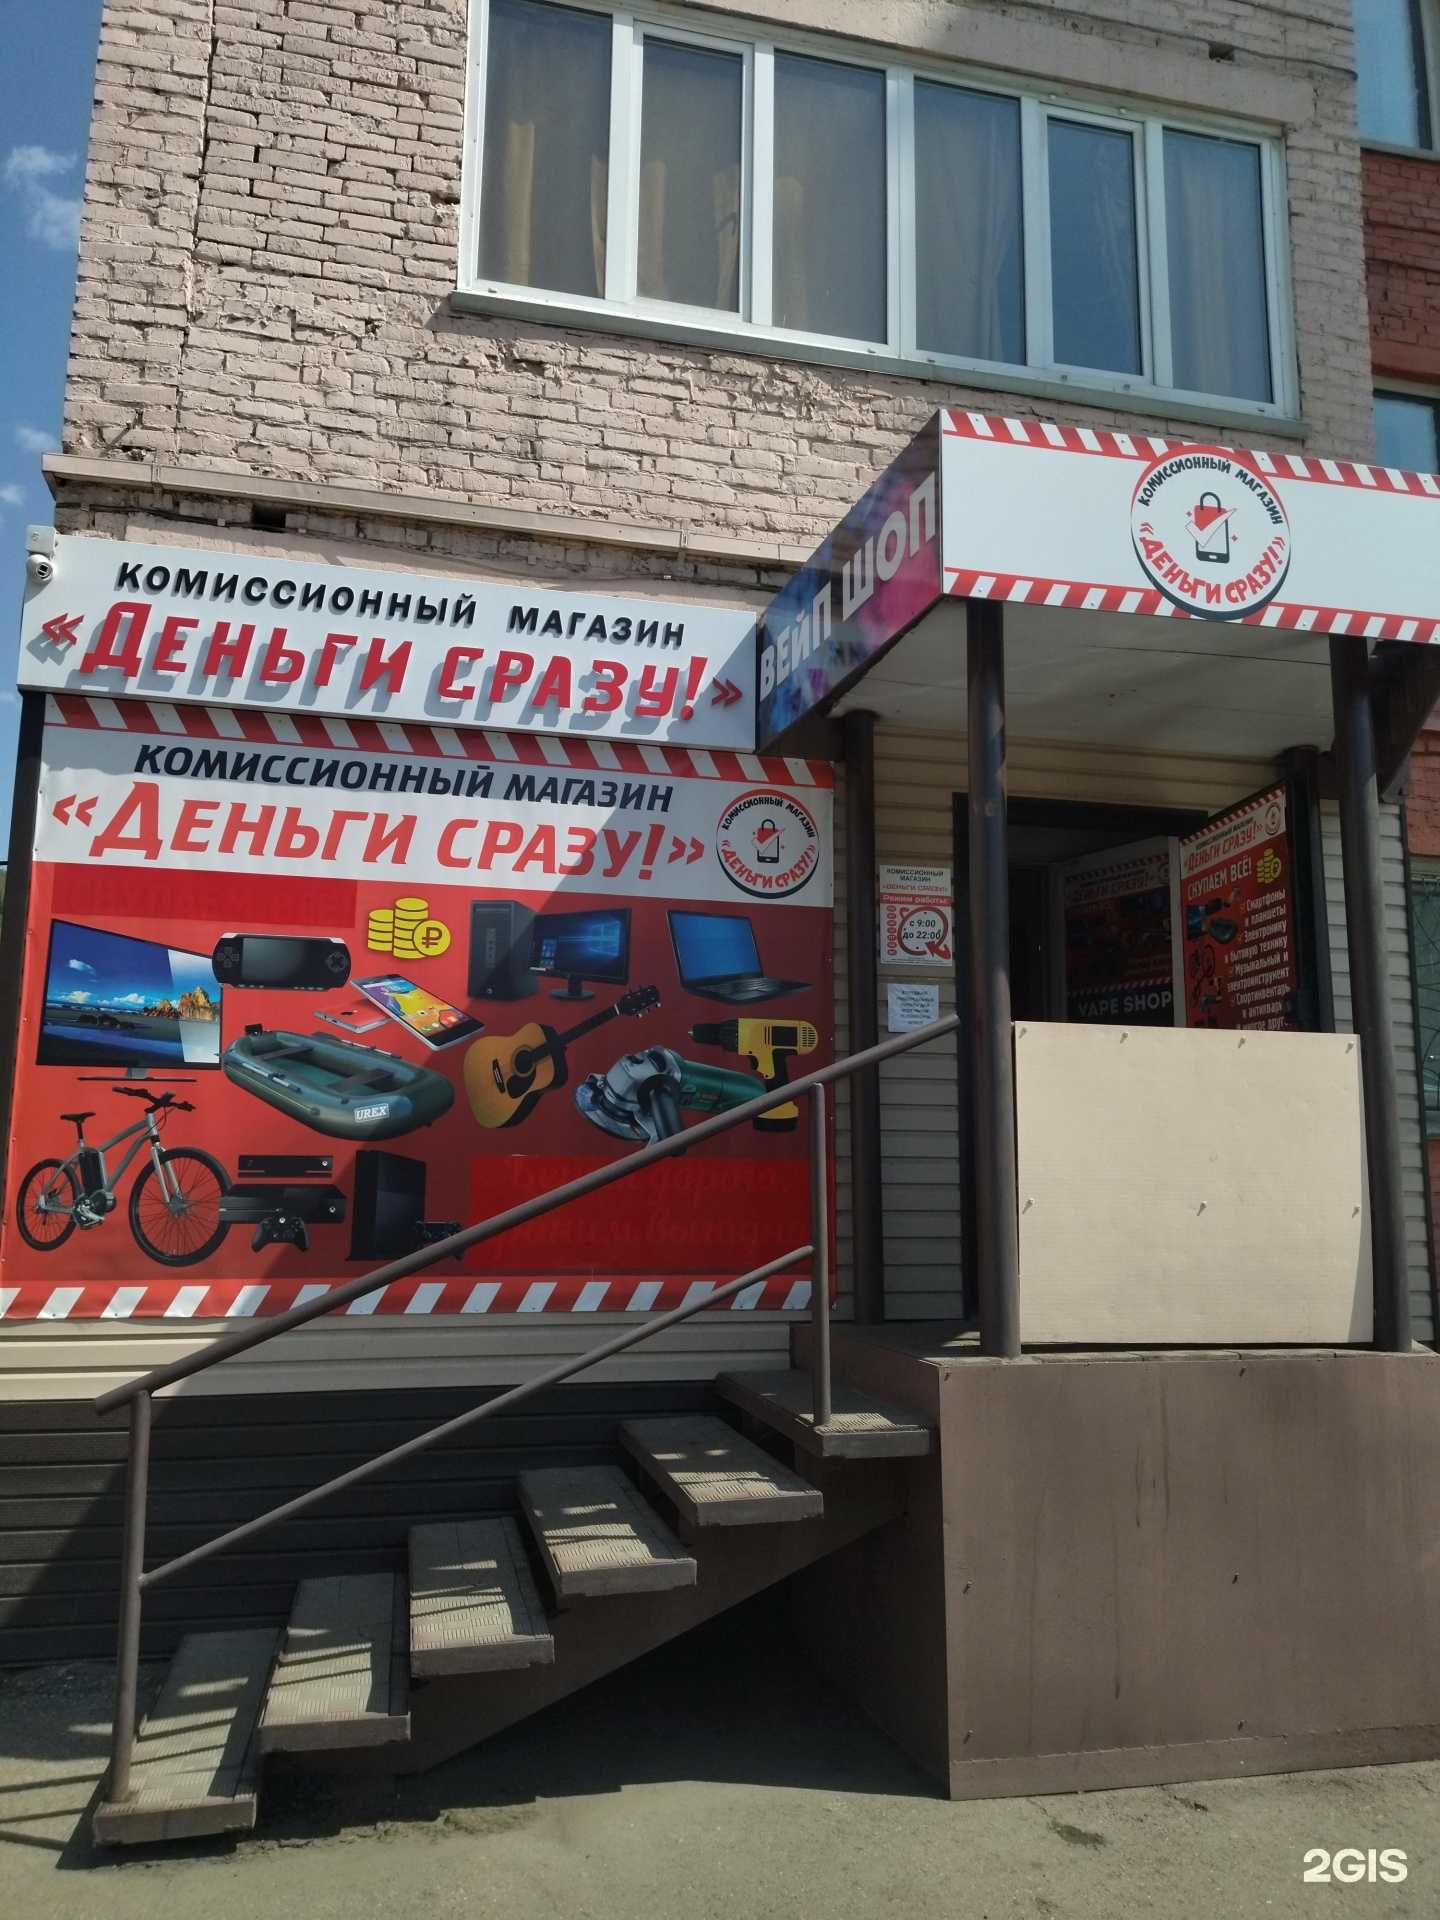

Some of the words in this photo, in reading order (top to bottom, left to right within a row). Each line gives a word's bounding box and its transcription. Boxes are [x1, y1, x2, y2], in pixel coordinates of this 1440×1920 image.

[1137, 455, 1231, 507] КОМИССИОННЫЙ
[1235, 469, 1284, 525] МАГАЗИН
[117, 562, 476, 626] КОМИССИОННЫЙ
[508, 605, 685, 648] МАГАЗИН
[760, 580, 832, 702] ВЕЙП
[842, 471, 936, 622] ШОП
[133, 744, 495, 799] КОМИССИОННЫЙ
[503, 773, 674, 812] МАГАЗИН
[902, 931, 914, 940] до
[916, 931, 941, 940] 22:00
[917, 919, 936, 928] 9:00
[1077, 998, 1120, 1020] VAPE
[1123, 991, 1172, 1014] SHOP
[356, 1106, 387, 1121] UREX
